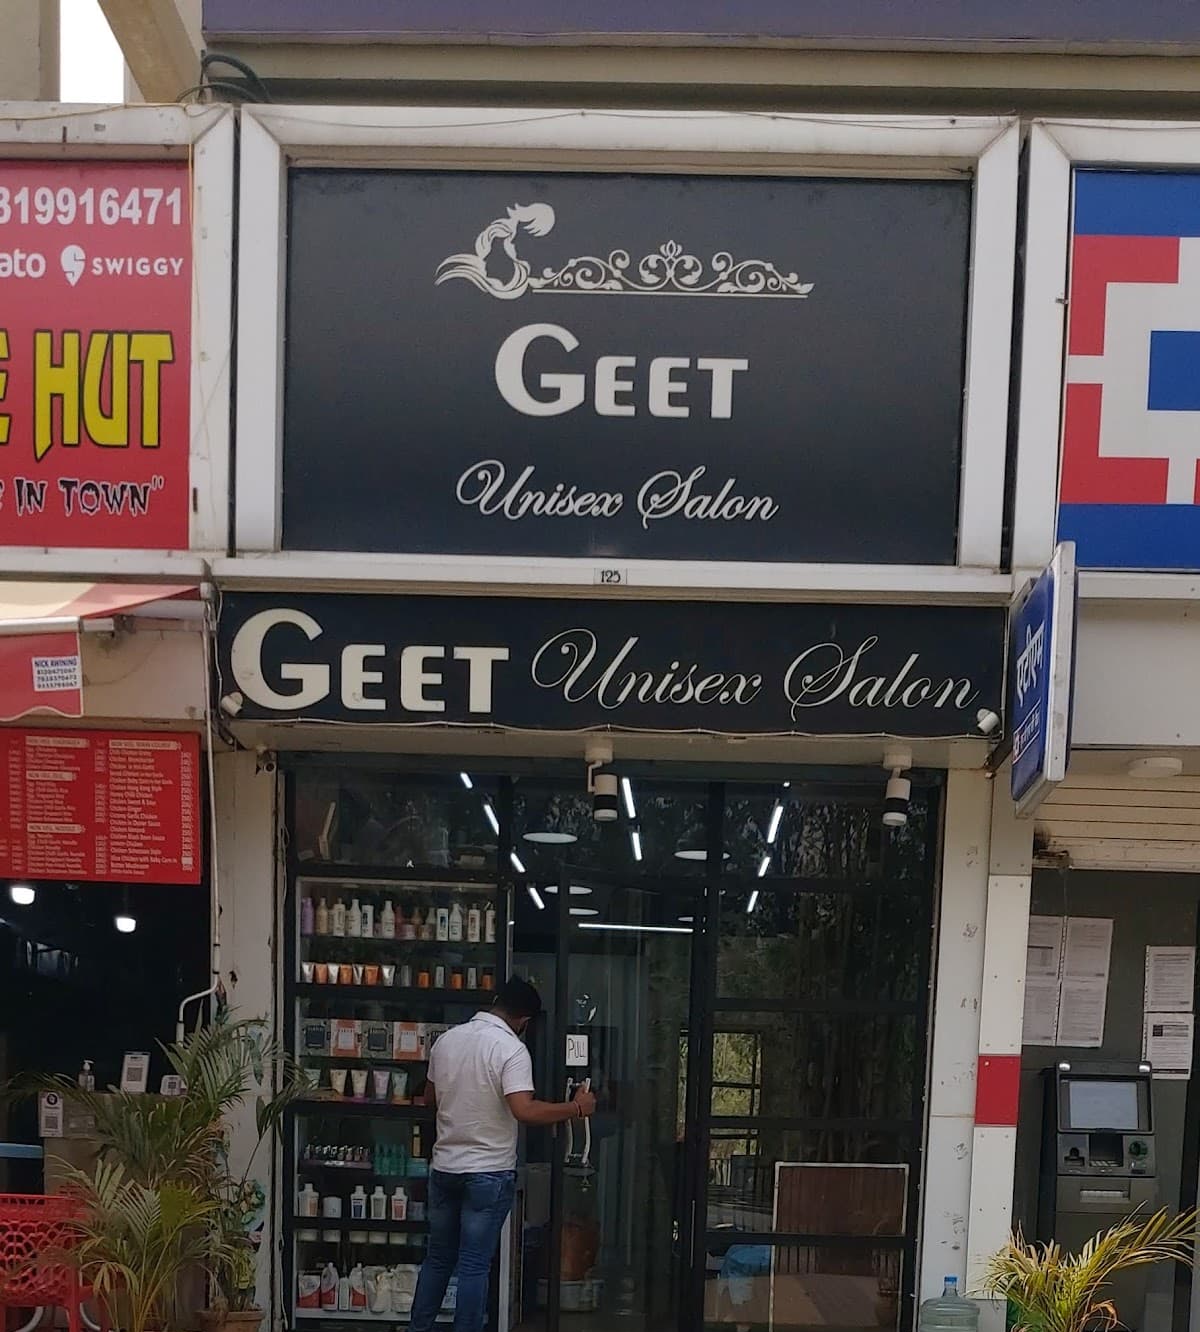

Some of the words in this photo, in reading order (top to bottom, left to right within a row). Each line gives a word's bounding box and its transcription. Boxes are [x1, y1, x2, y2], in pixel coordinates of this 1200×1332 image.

[91, 257, 184, 276] SWIGGY
[34, 330, 175, 463] HUT
[494, 323, 749, 420] GEET
[13, 476, 48, 516] IN
[455, 458, 623, 520] Unisex
[637, 465, 780, 530] Salon
[601, 569, 621, 583] 125
[230, 607, 510, 714] GEET
[530, 627, 763, 711] Unisex
[783, 634, 981, 723] Salon
[568, 1038, 587, 1059] PULL
